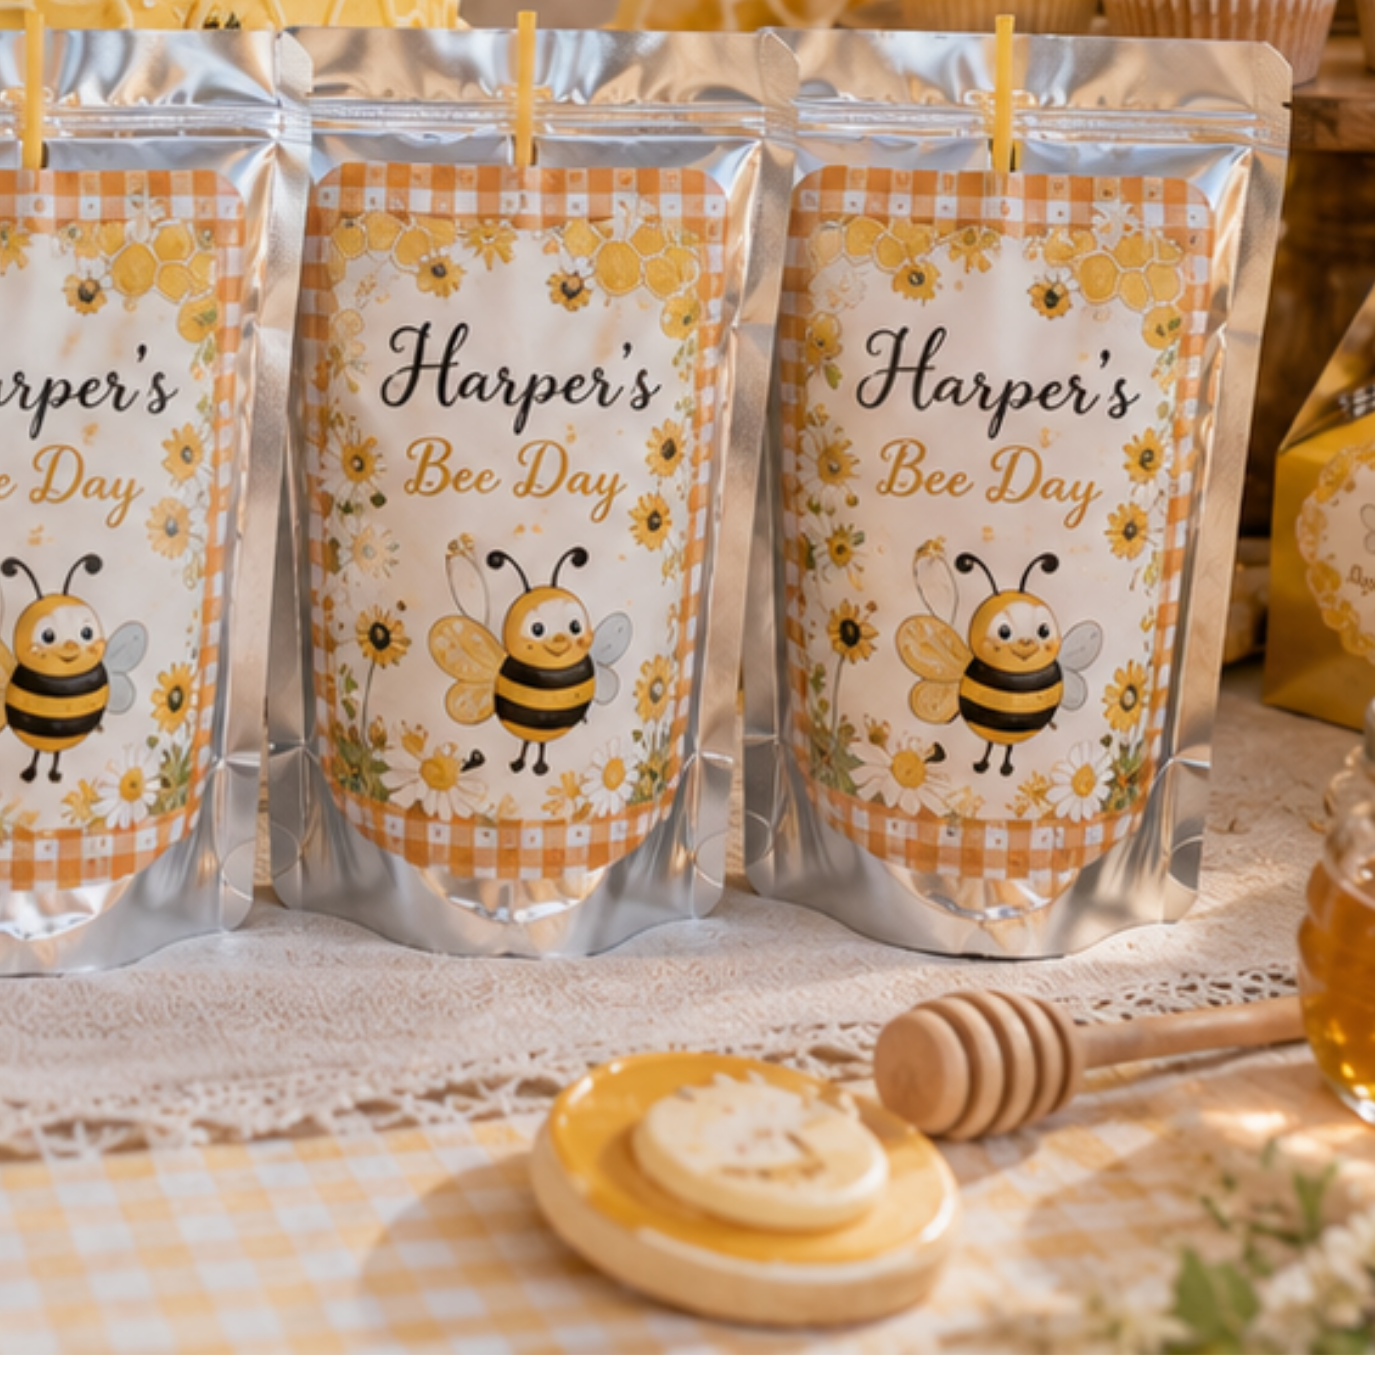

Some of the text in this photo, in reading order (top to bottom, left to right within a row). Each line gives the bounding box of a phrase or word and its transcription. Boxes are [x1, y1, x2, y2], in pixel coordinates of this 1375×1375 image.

[379, 320, 663, 436] Harper's
[855, 325, 1142, 440] Harper's
[27, 443, 145, 529] Day
[402, 436, 628, 524] Bee Day
[875, 437, 1104, 530] Bee Day
